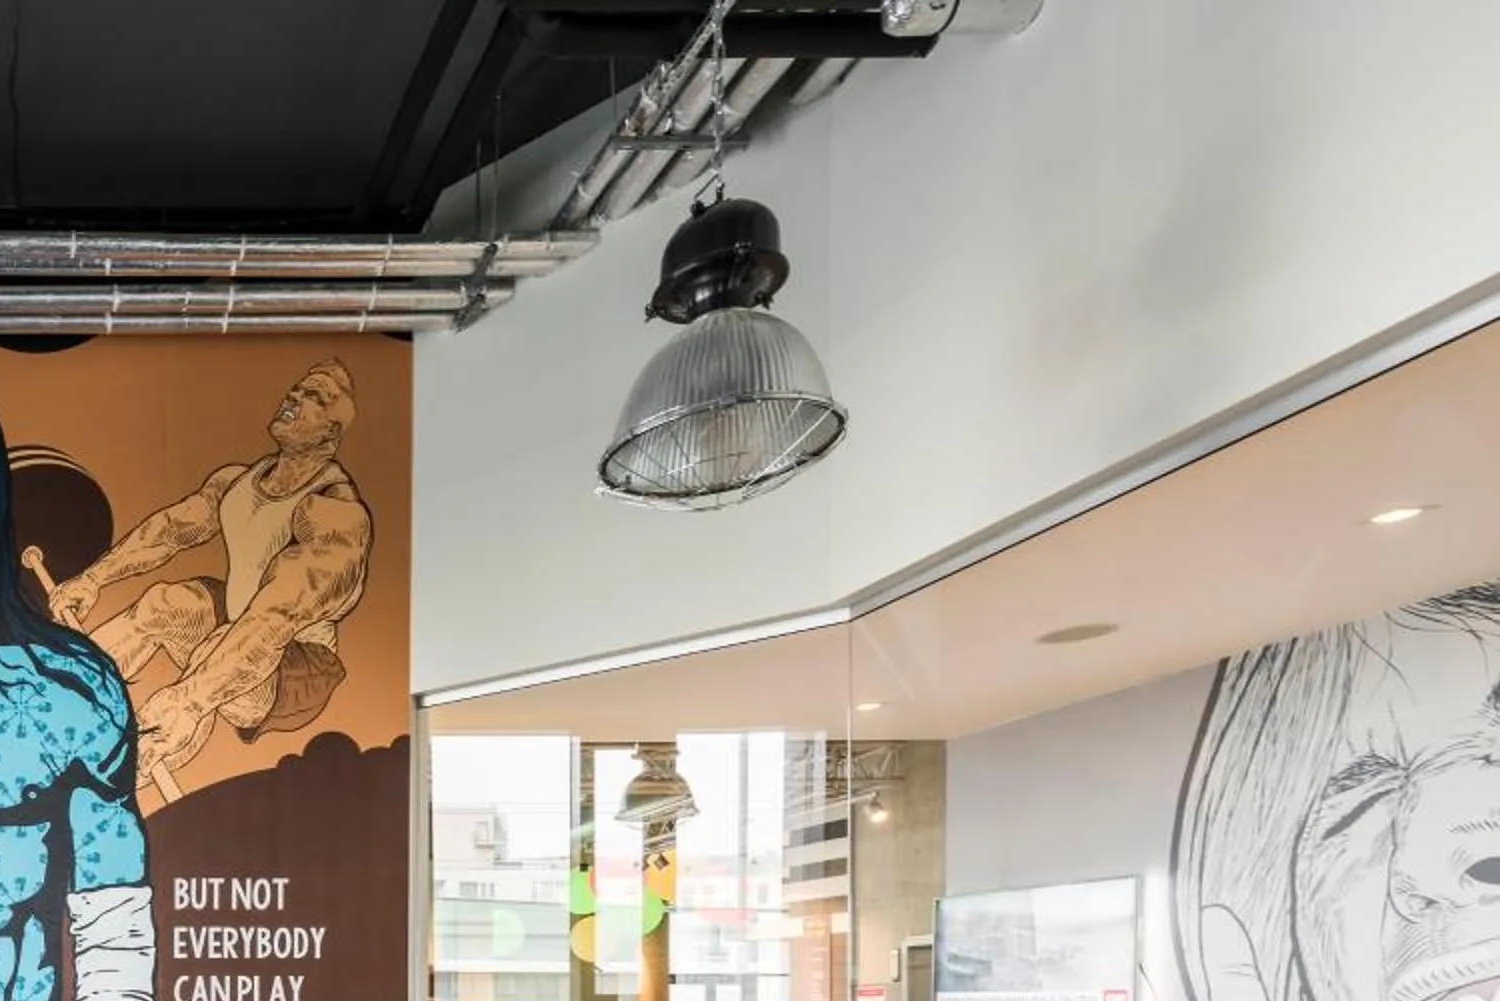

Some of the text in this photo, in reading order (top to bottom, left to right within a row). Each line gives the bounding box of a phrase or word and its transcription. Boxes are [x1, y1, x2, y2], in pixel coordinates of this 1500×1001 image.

[174, 877, 289, 910] BUT NOT
[173, 926, 326, 959] EVERYBODY
